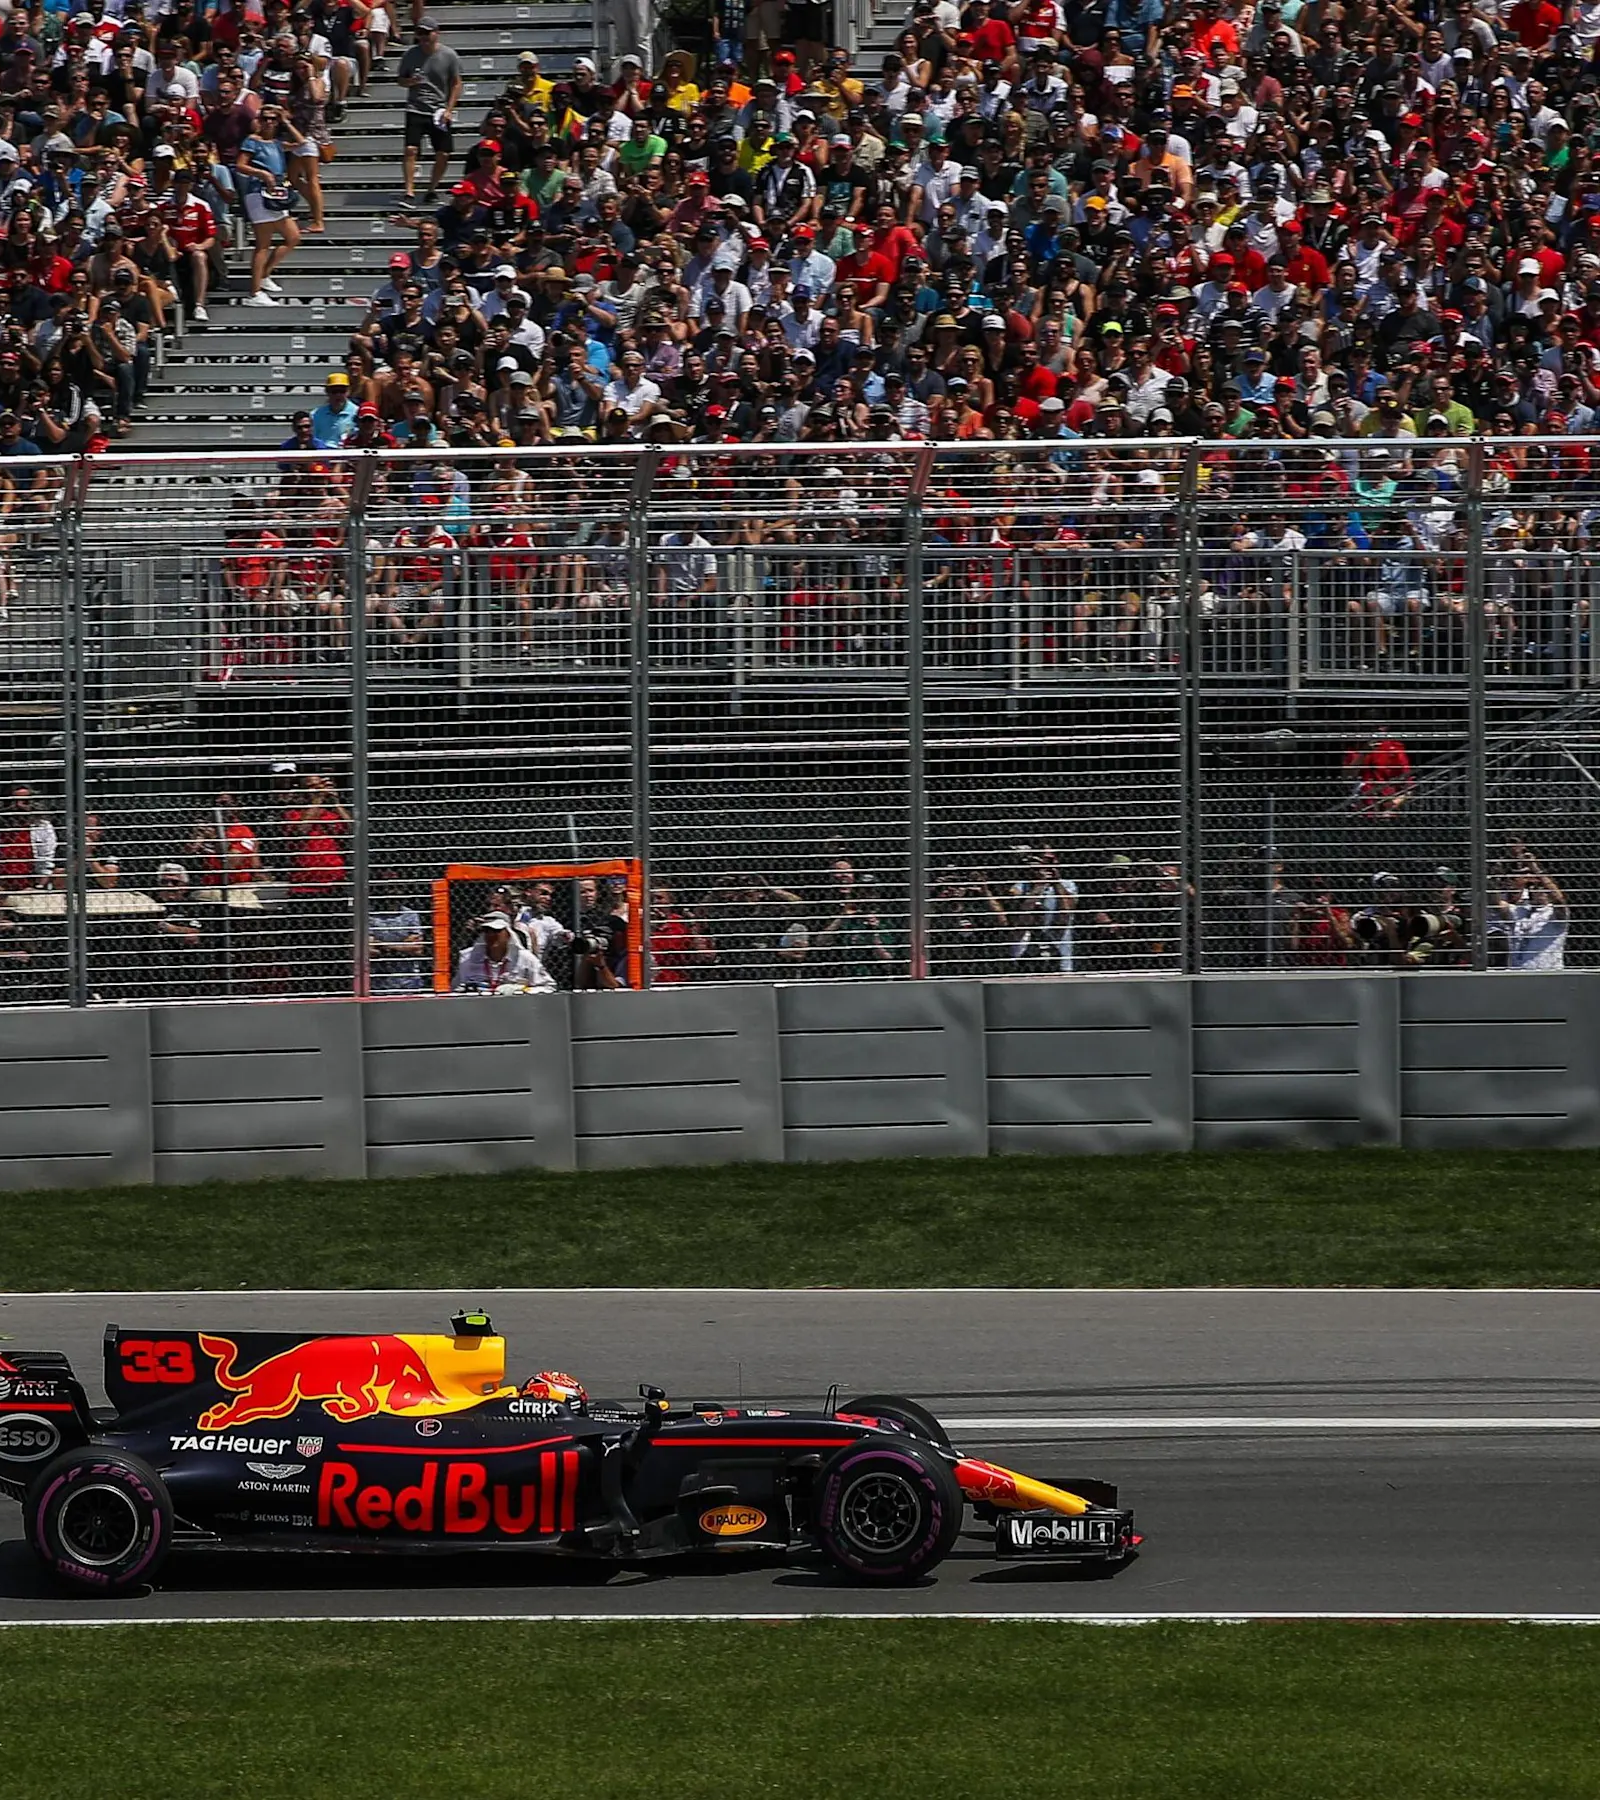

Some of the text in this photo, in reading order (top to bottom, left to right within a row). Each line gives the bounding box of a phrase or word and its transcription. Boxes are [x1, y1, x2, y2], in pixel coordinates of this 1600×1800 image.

[120, 1340, 196, 1384] 33
[90, 1464, 154, 1501] ZERO
[238, 1481, 310, 1493] ASTON MARTIN
[254, 1513, 289, 1523] SIEMENS
[292, 1514, 313, 1527] IBM
[716, 1513, 757, 1526] RAUCH
[1011, 1519, 1084, 1545] Mobil
